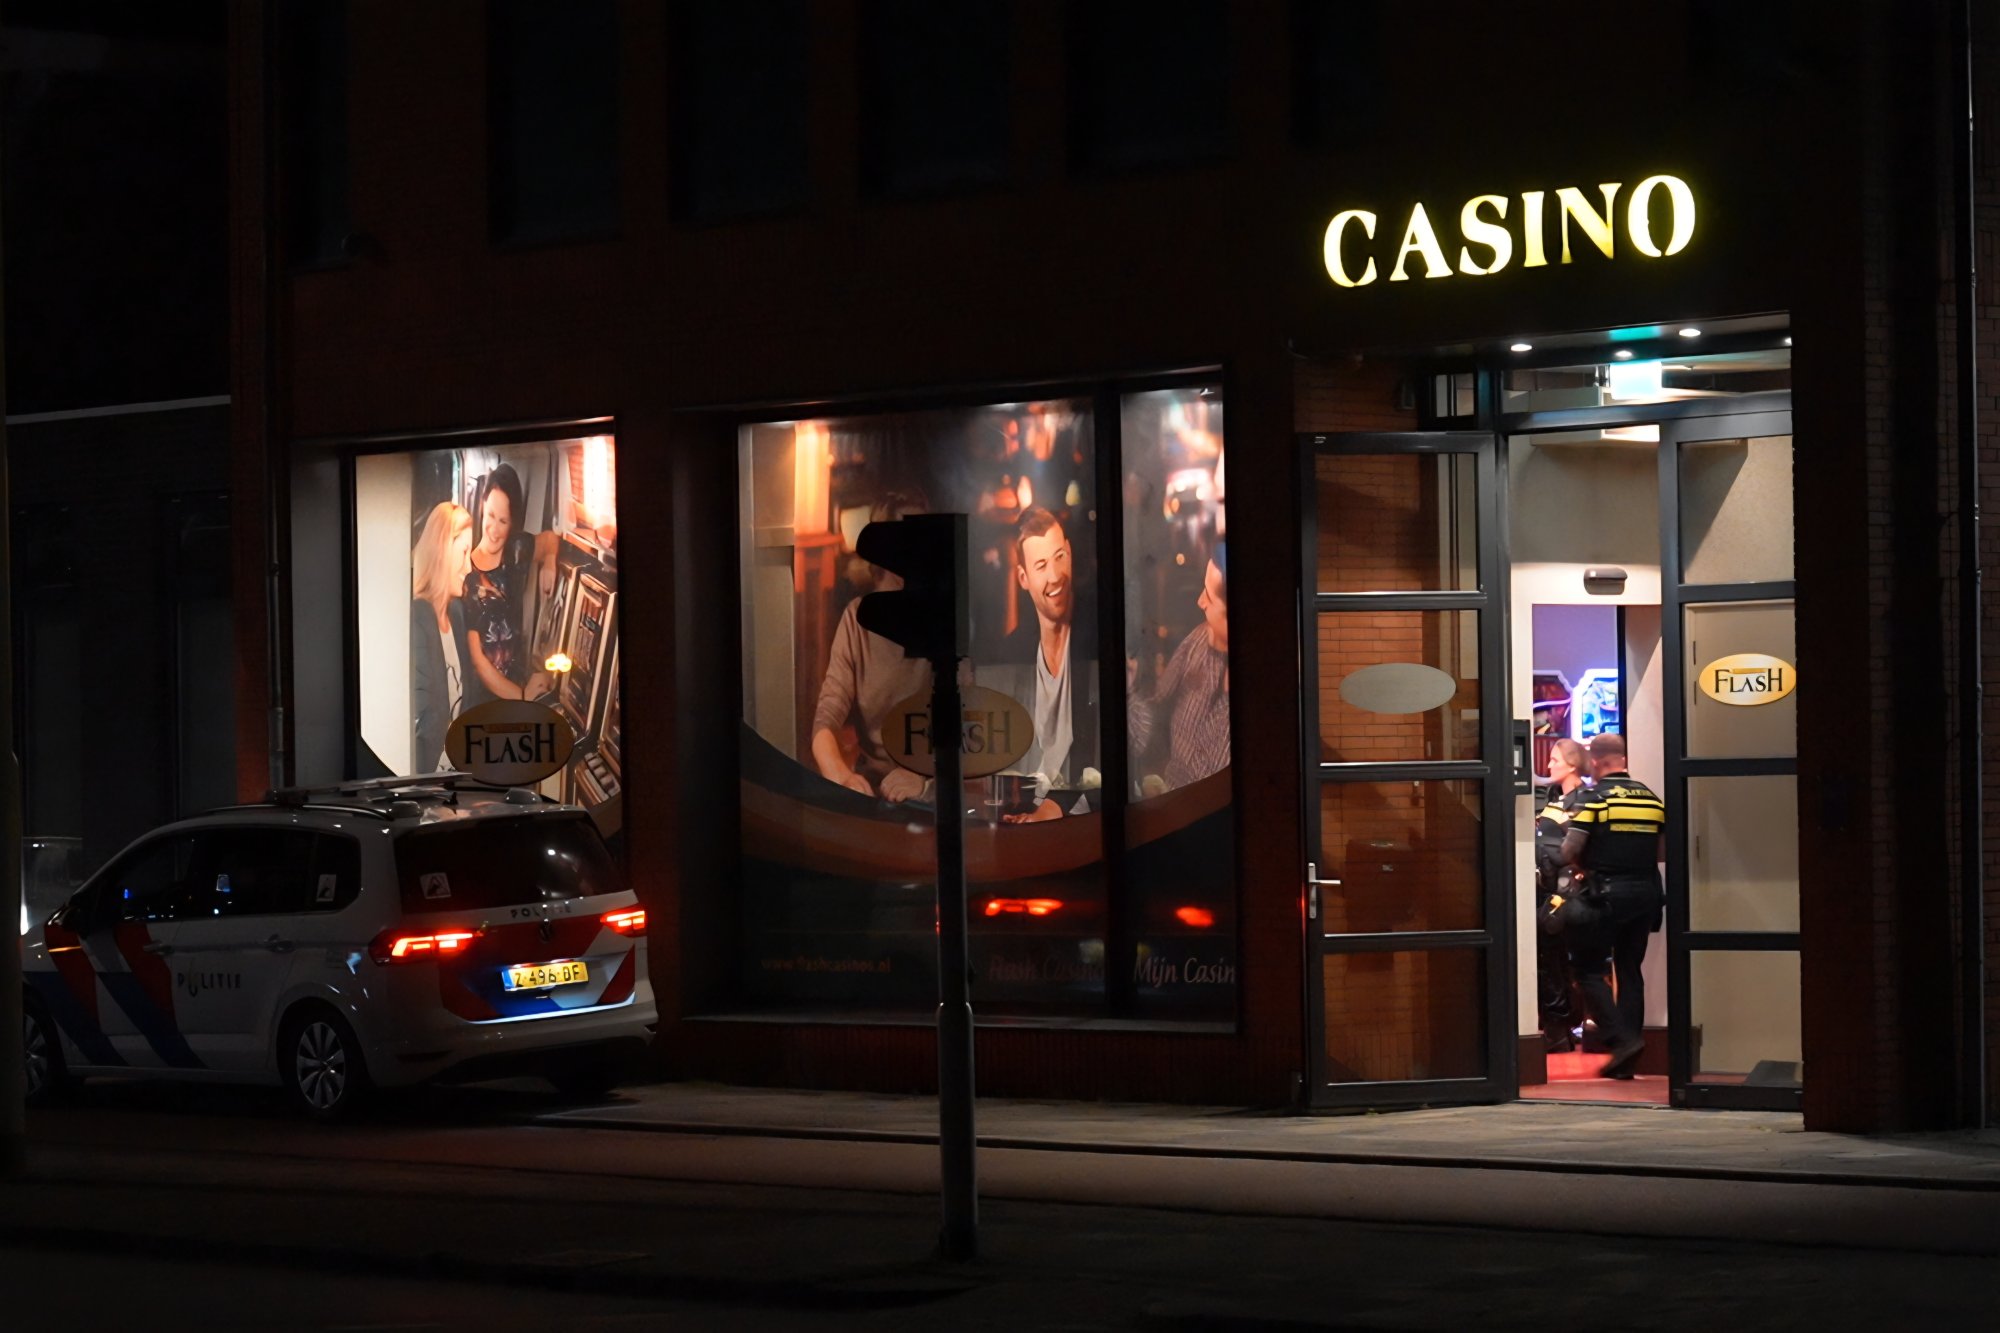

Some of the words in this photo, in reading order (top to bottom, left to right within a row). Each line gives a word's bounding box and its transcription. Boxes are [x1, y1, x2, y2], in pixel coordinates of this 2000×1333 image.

[1324, 175, 1696, 287] CASINO
[1714, 668, 1783, 693] FLASH
[464, 723, 556, 764] FLASH
[904, 711, 1012, 755] FSH
[510, 905, 571, 918] POLIIE
[1134, 956, 1178, 989] Mijn
